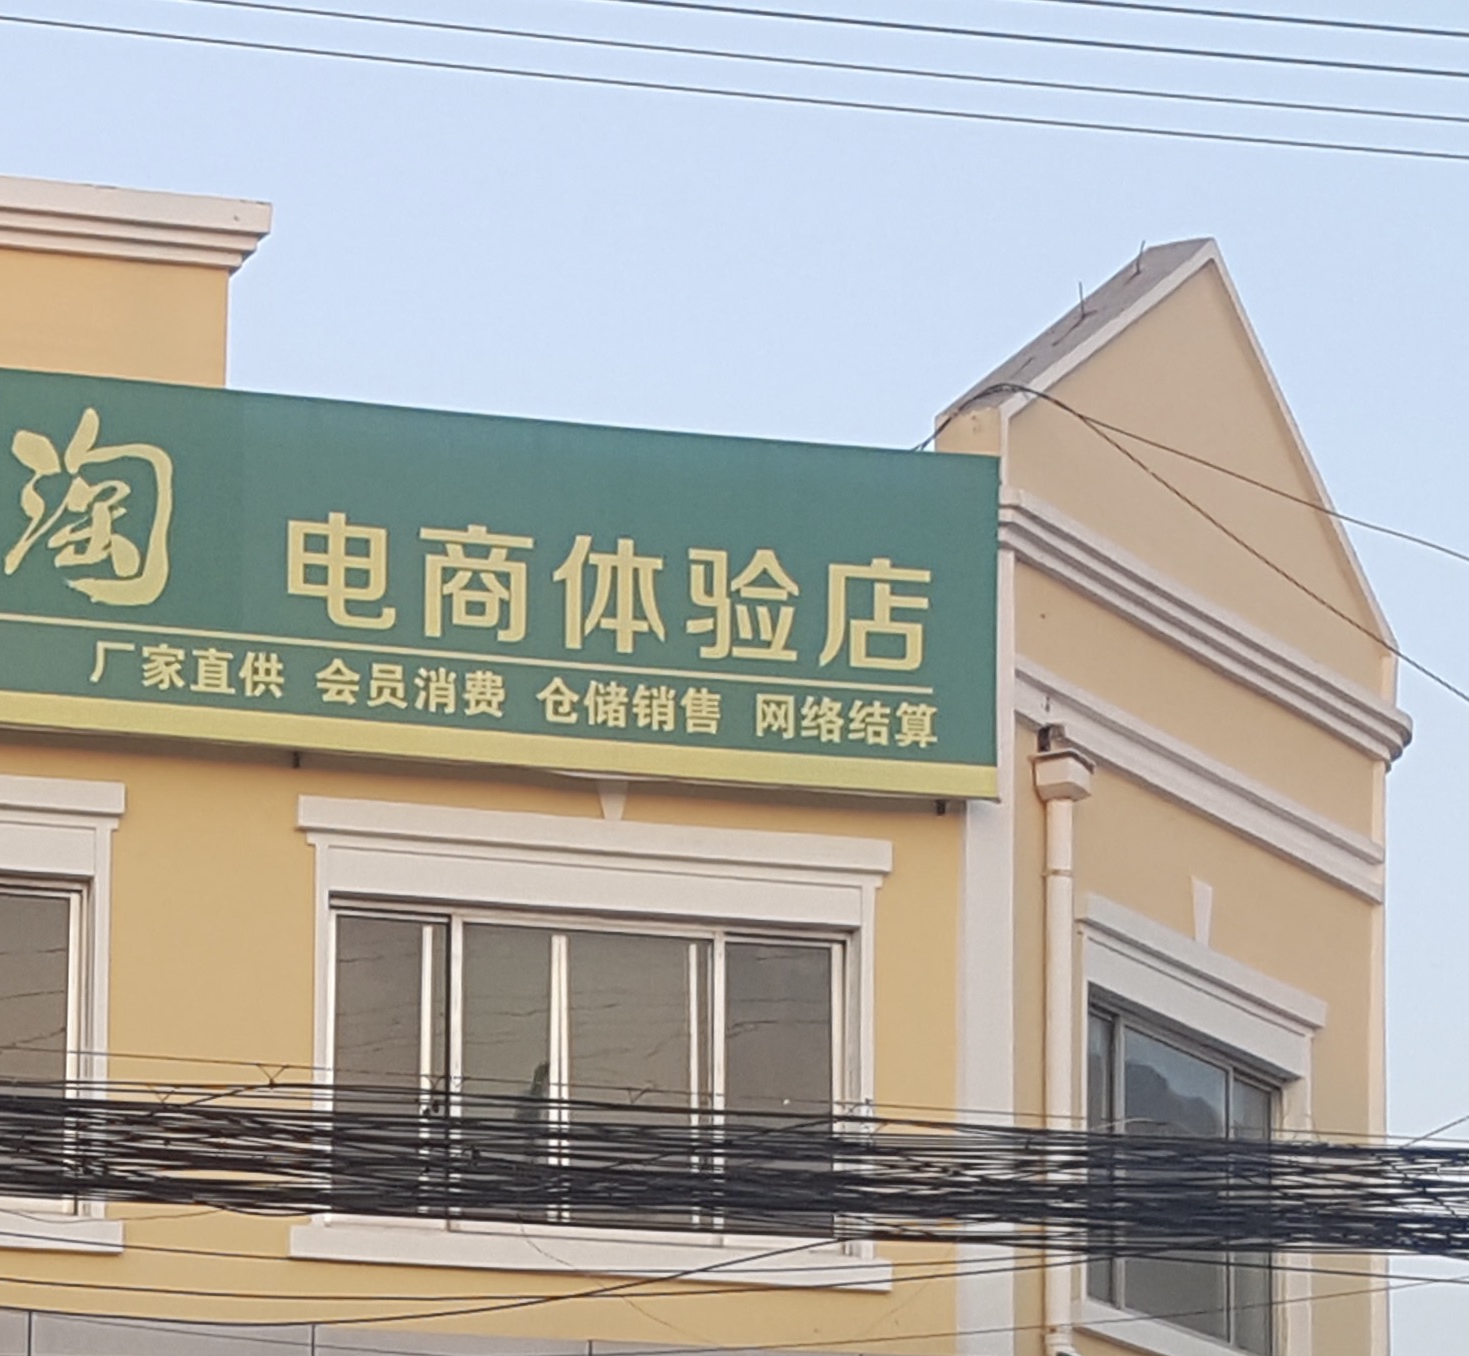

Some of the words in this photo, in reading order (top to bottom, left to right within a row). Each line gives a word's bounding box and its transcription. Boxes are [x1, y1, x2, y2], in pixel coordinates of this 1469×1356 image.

[286, 512, 932, 672] 电商体验店
[90, 640, 285, 699] 厂家直供
[315, 659, 507, 719] 会员消费
[536, 677, 723, 736] 仓储销售
[754, 693, 939, 749] 网络结算
